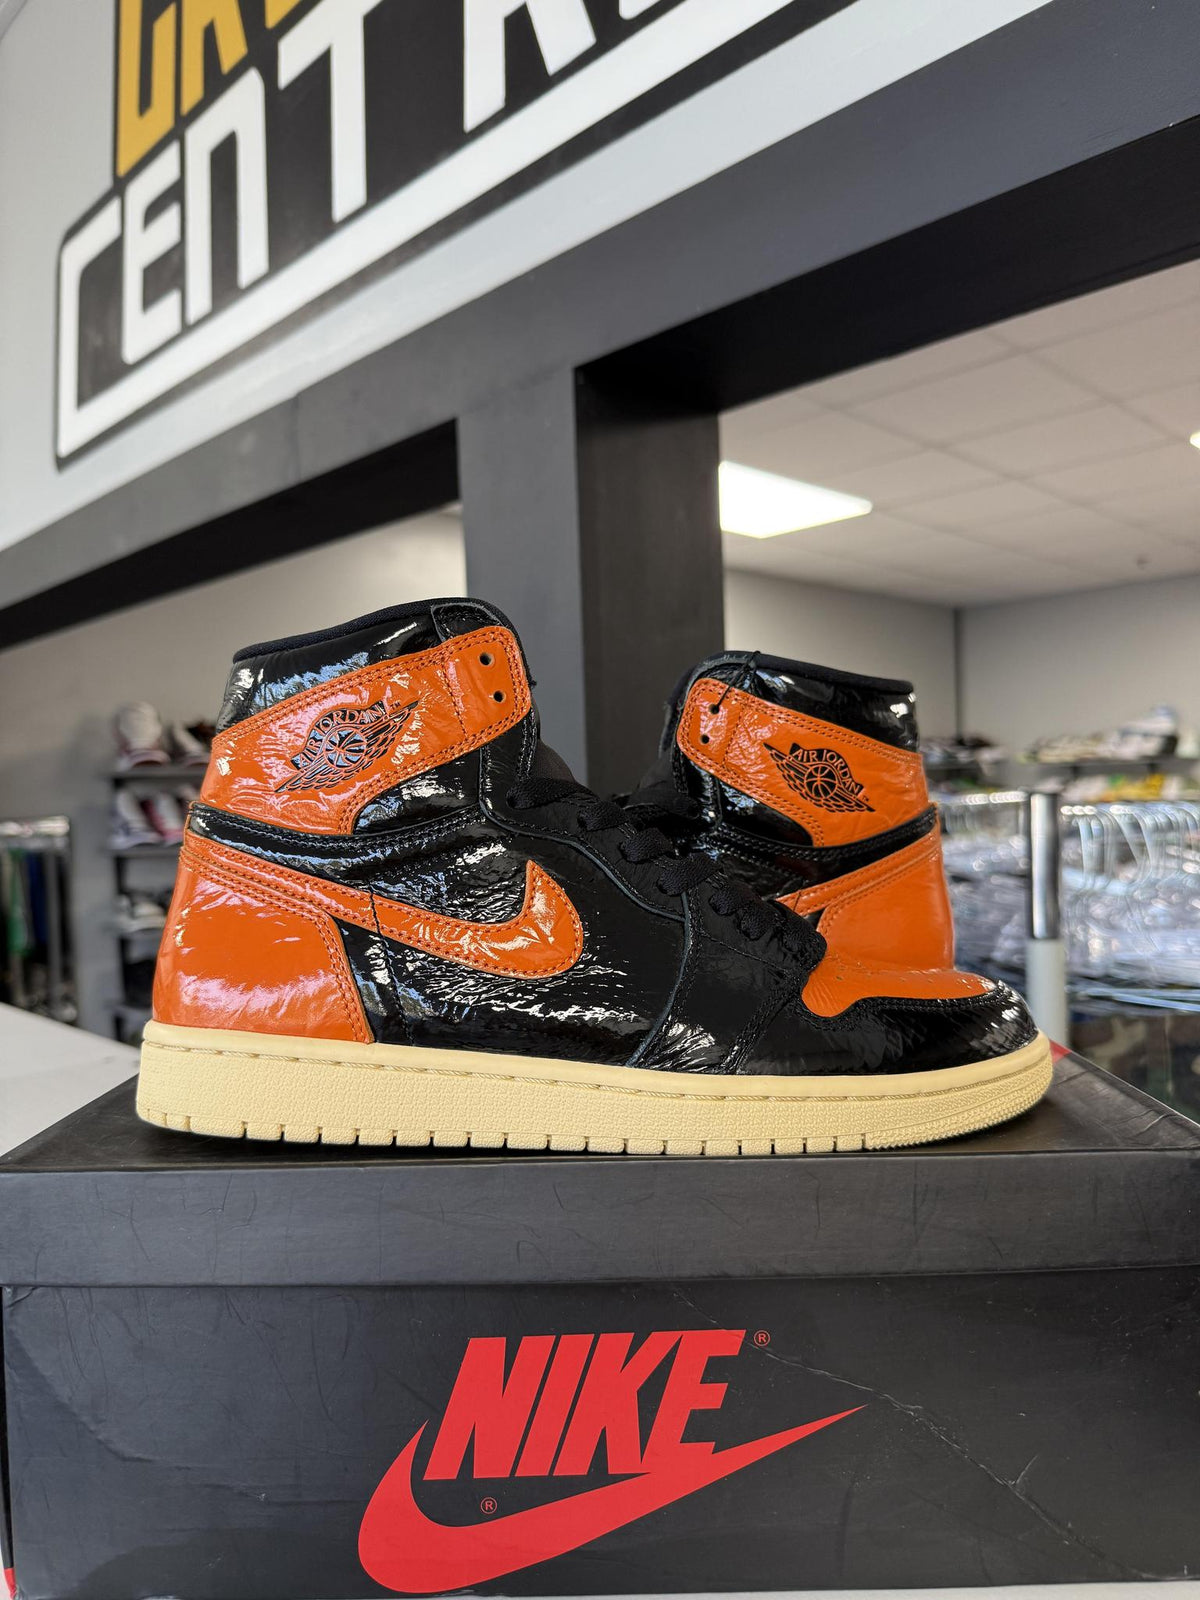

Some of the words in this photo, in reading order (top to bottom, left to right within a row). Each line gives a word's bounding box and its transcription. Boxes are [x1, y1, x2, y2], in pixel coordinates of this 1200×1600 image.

[299, 738, 322, 769] AIR
[314, 702, 388, 736] JORDAN
[792, 748, 818, 763] AIR
[821, 748, 861, 796] JORDAN
[423, 1329, 747, 1480] NIKE
